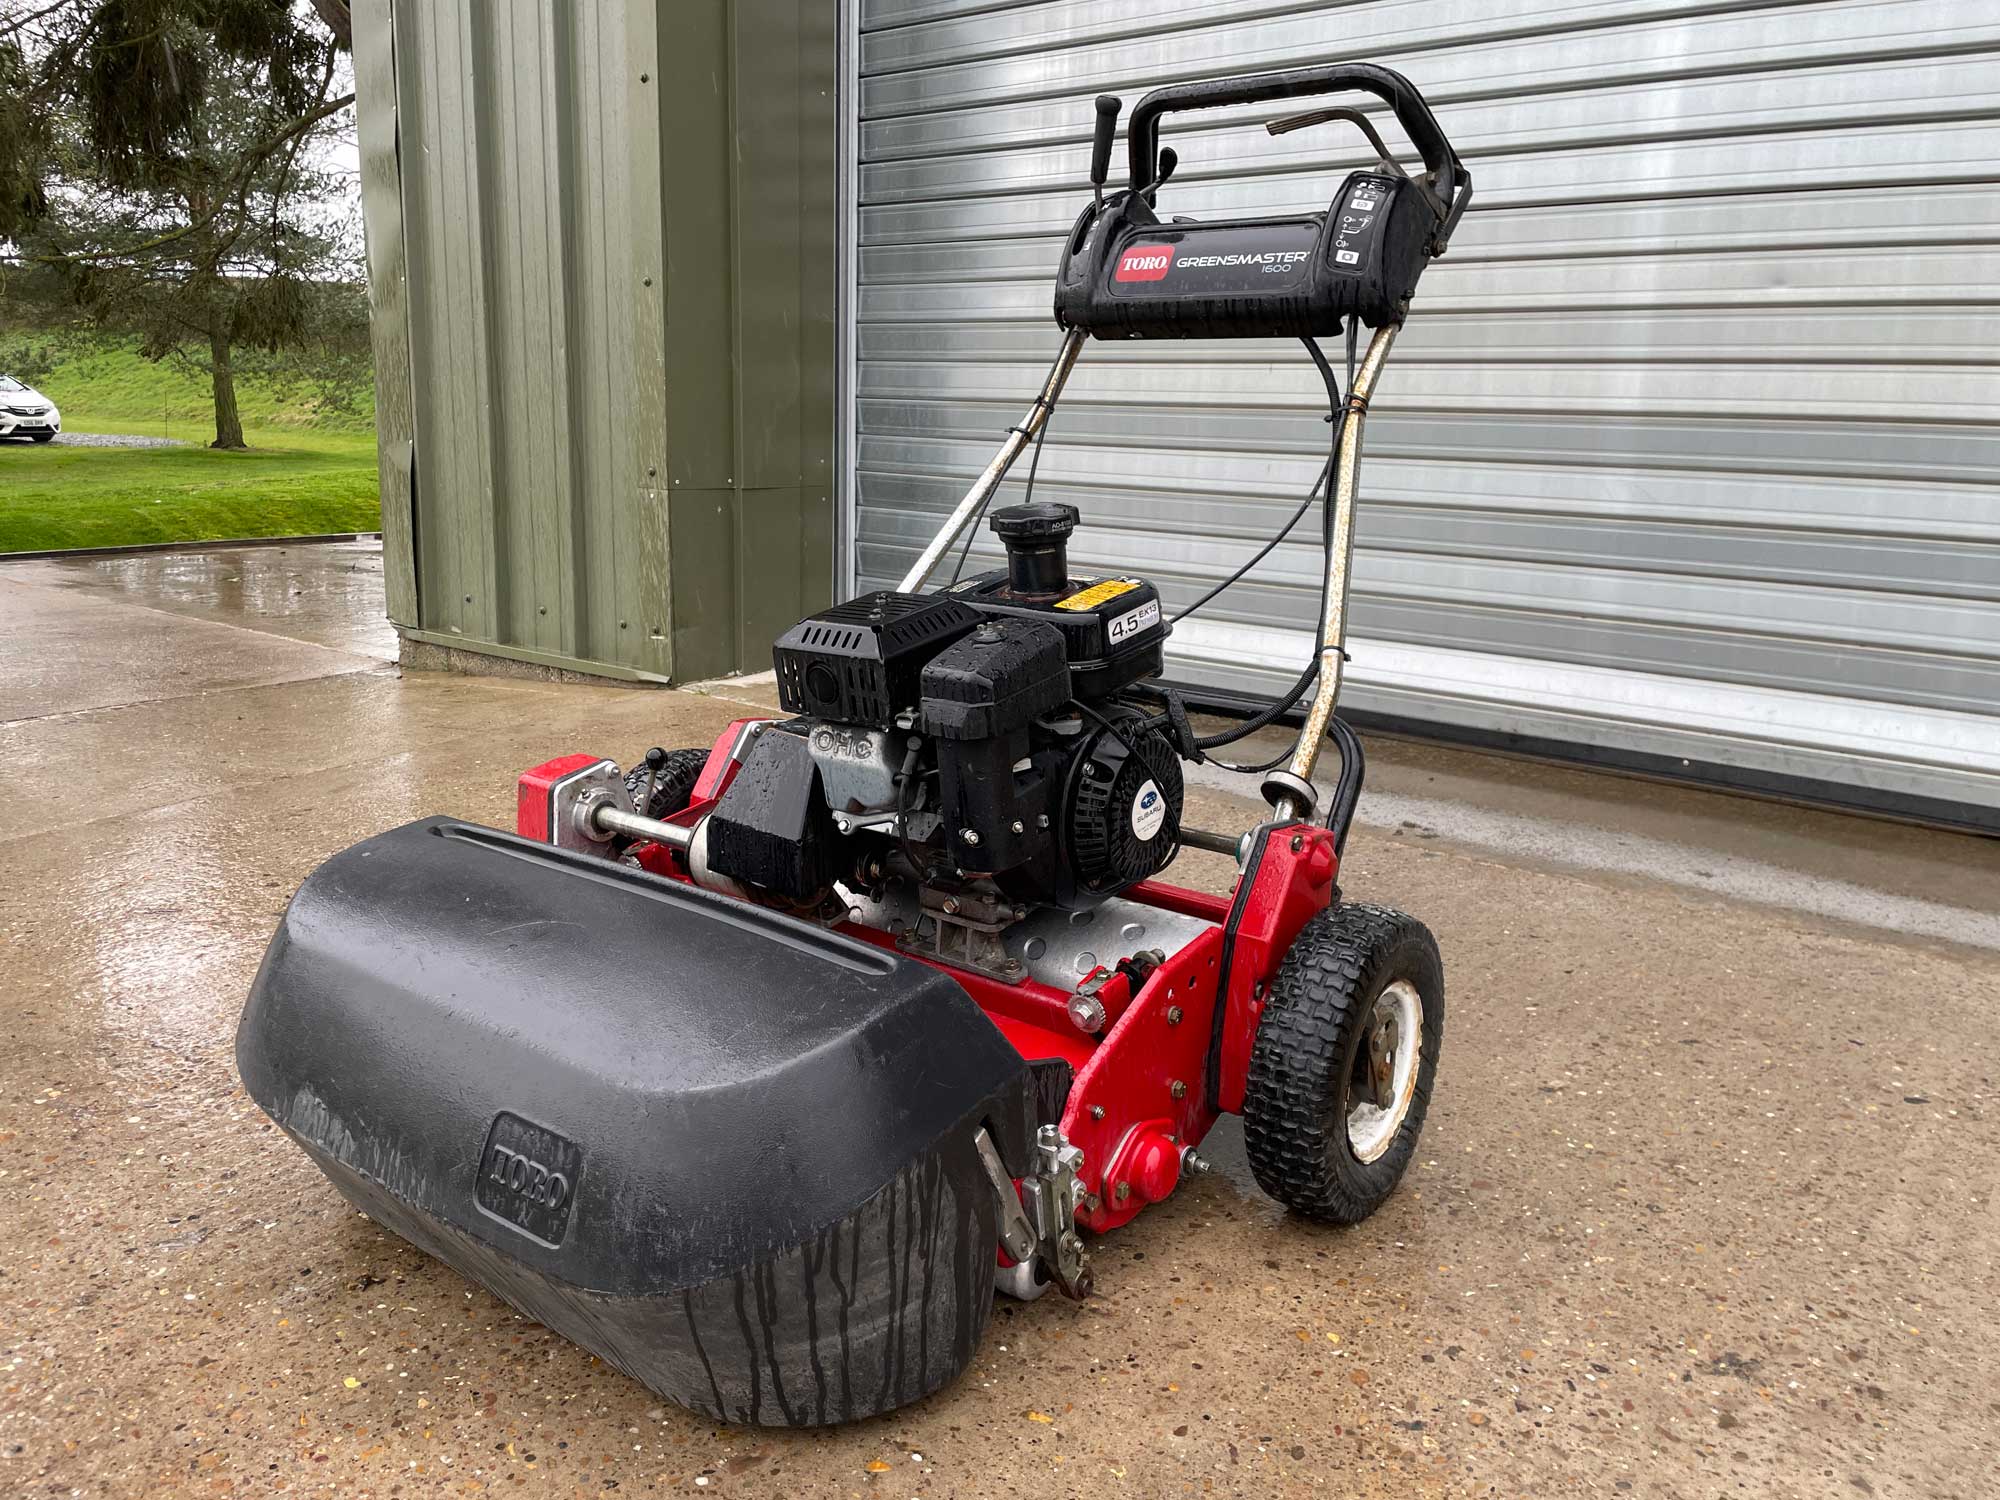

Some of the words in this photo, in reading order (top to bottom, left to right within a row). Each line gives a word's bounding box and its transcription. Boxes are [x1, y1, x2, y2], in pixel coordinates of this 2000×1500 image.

[1123, 255, 1168, 271] TORO
[1176, 251, 1308, 268] GREENSMASTER
[1261, 263, 1292, 273] 1600
[1138, 603, 1157, 618] EX13
[1111, 614, 1139, 637] 4.5
[815, 730, 873, 760] OHC
[1136, 804, 1162, 823] SUBARU
[490, 1144, 569, 1210] TORO
